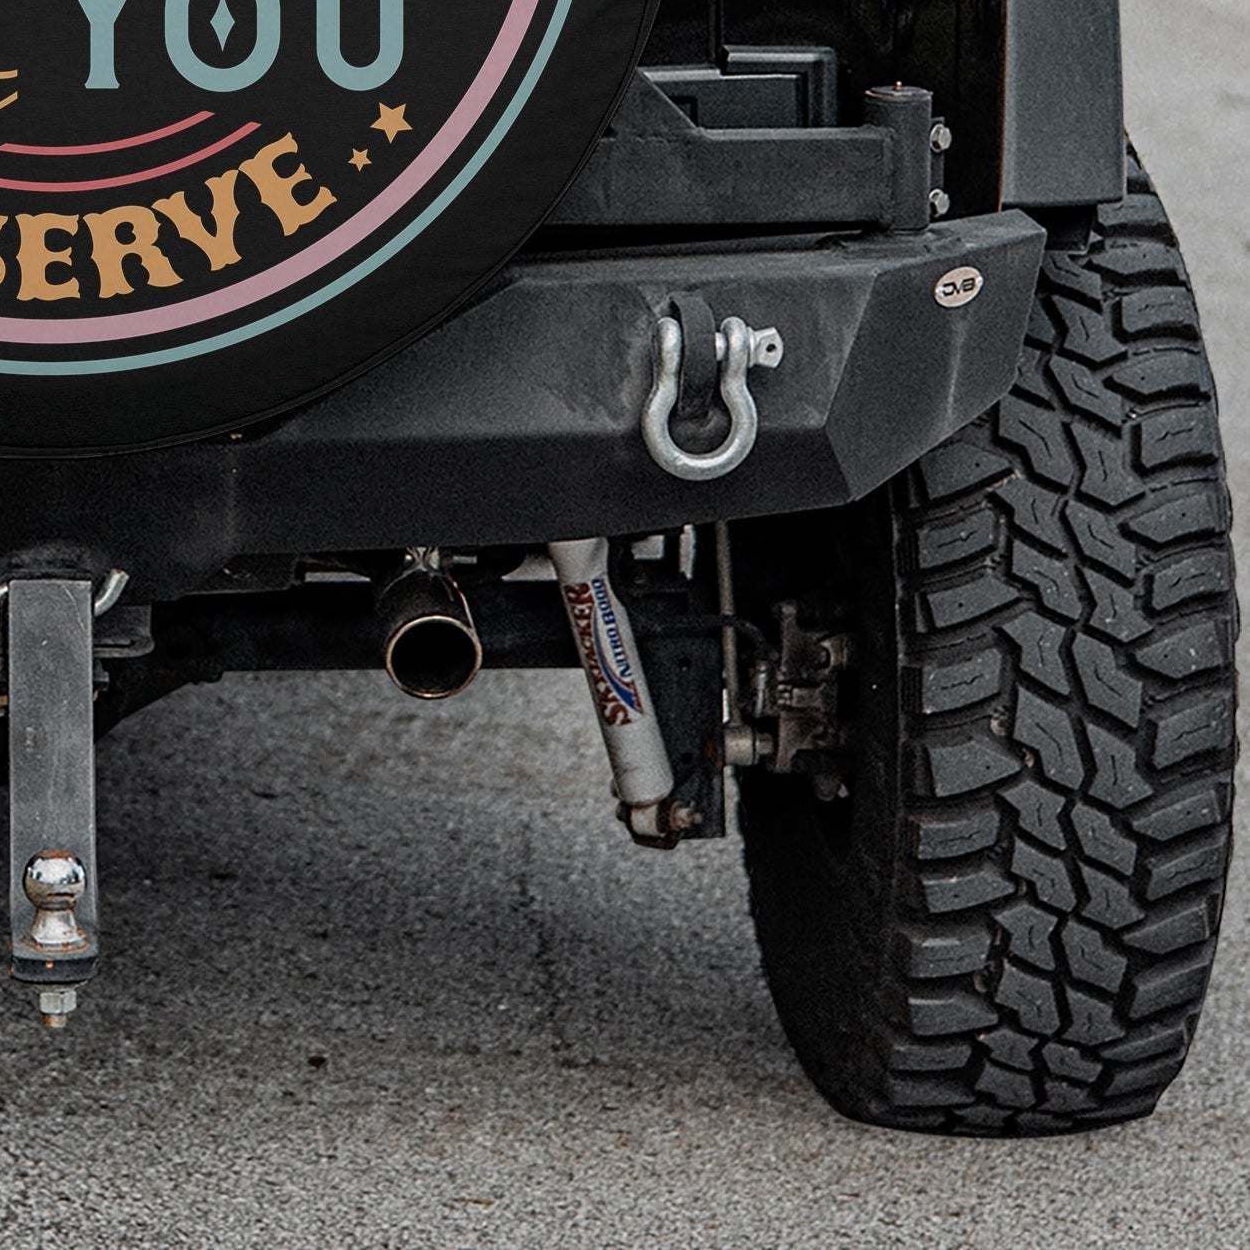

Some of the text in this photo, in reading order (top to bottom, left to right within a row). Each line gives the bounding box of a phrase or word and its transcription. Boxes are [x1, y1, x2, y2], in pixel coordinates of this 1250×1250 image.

[563, 581, 631, 726] SKYJACKER
[590, 577, 631, 678] NITRO 8000
